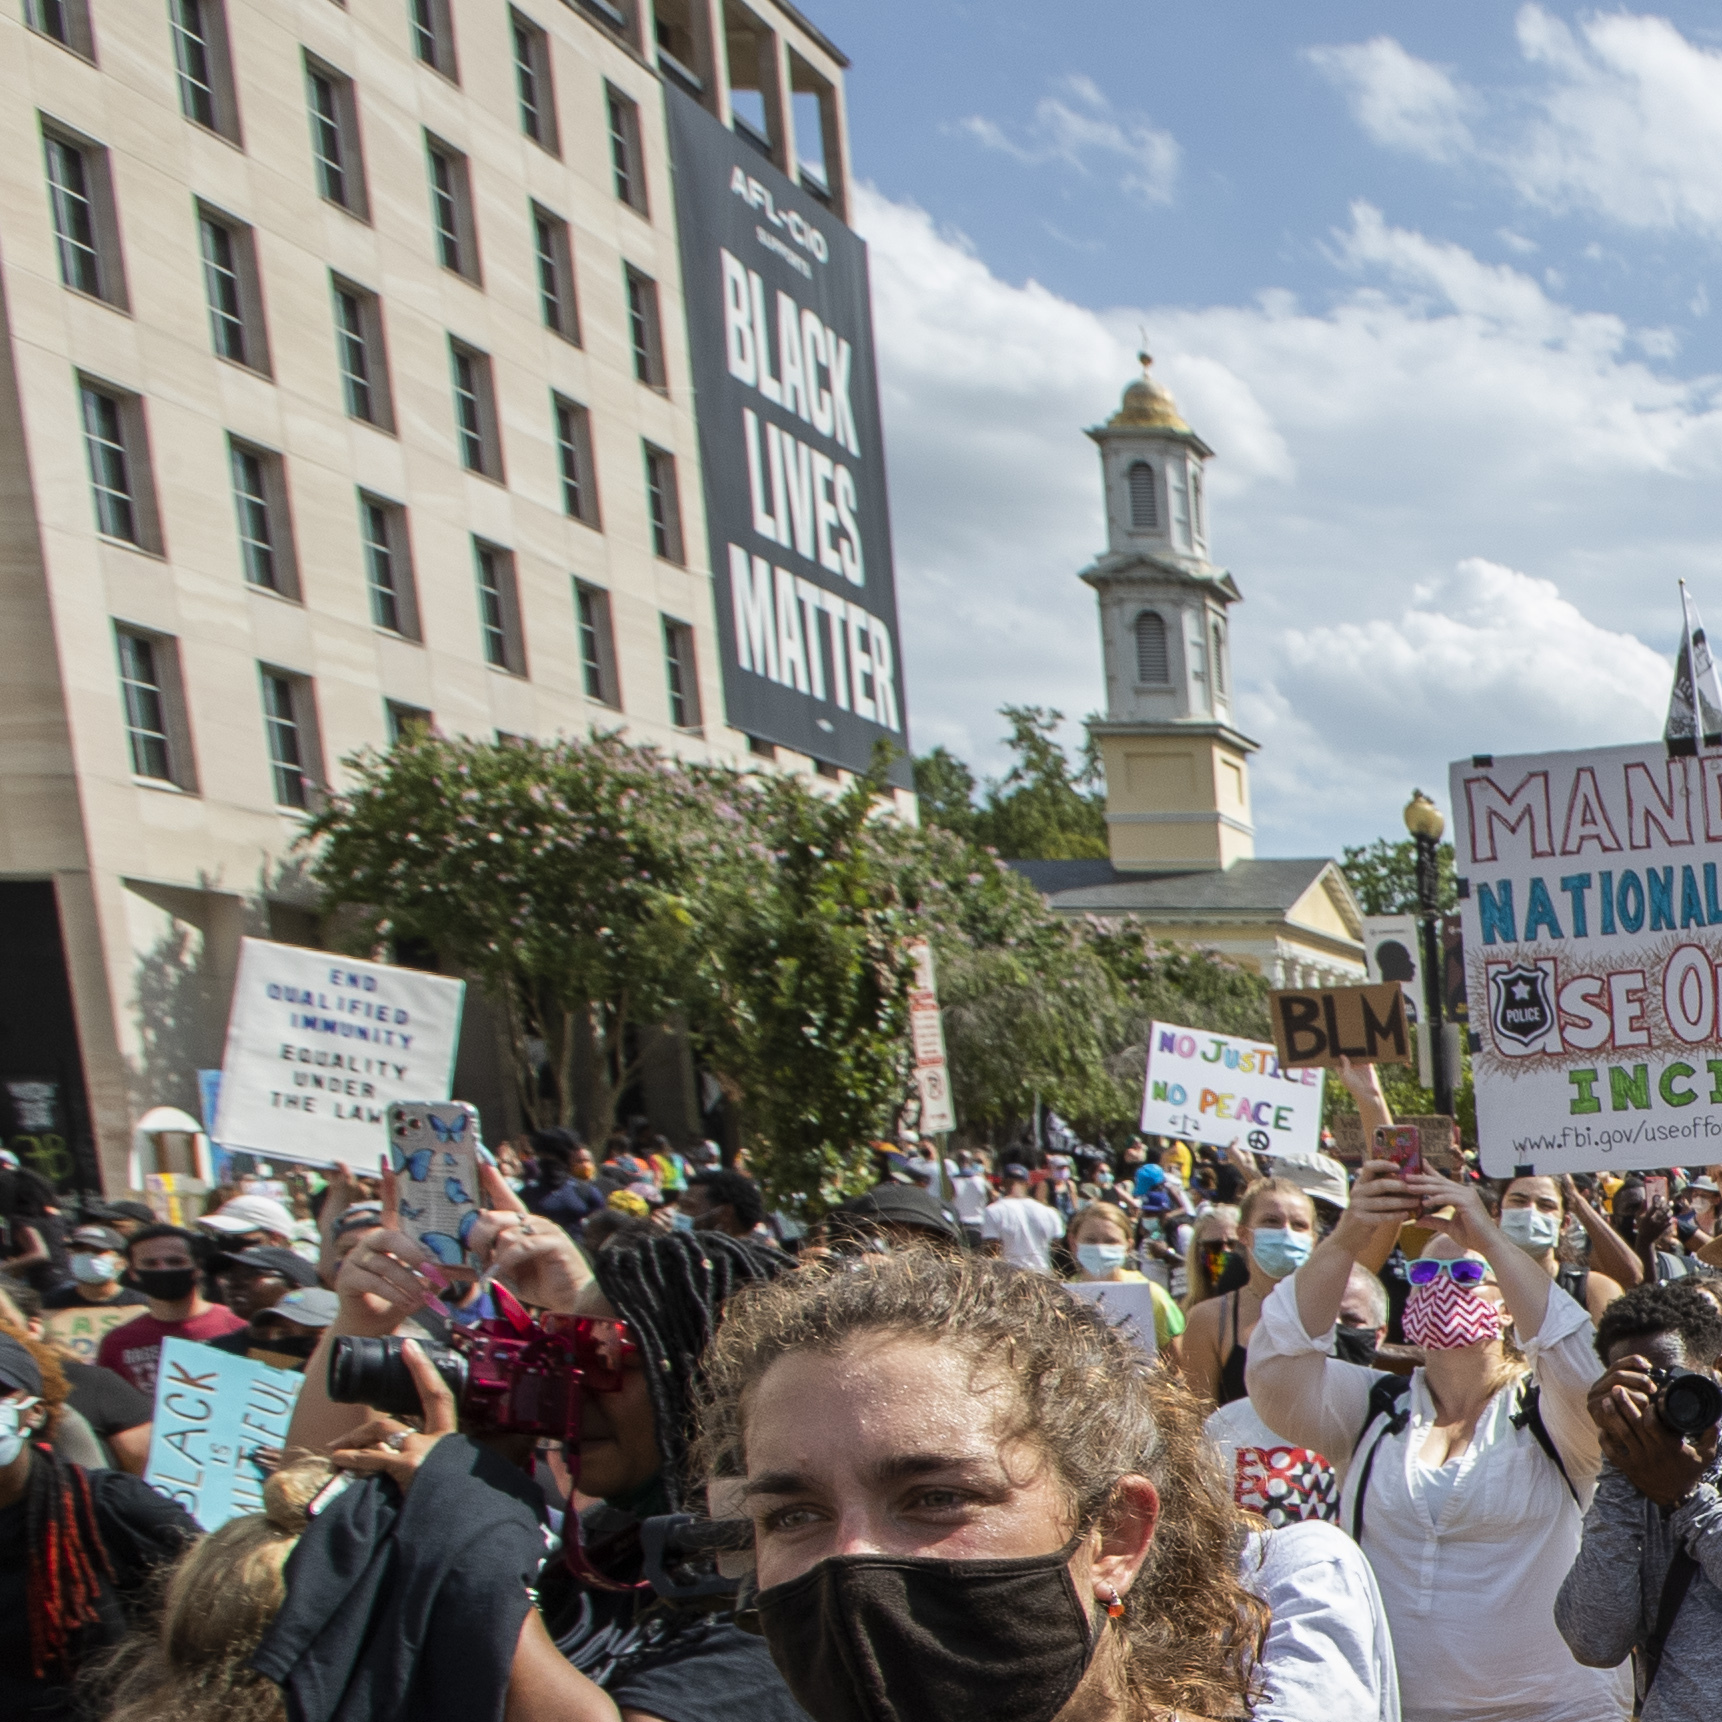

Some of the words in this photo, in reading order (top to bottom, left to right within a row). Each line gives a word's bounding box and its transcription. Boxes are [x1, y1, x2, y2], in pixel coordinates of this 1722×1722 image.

[730, 163, 829, 264] AFL-CIO
[720, 246, 861, 459] BLACK
[743, 406, 867, 588] LIVES
[727, 542, 901, 735] MATTER
[265, 982, 411, 1026] QUALIFIED
[328, 968, 378, 992] END
[290, 1012, 413, 1051] IMMUNITY
[1278, 990, 1408, 1062] BLM
[1485, 957, 1652, 1059] USE
[1505, 1006, 1541, 1024] POLICE
[280, 1043, 408, 1081] EQUALITY
[293, 1070, 376, 1098] UNDER
[1159, 1029, 1196, 1058] NO
[1200, 1038, 1319, 1087] JUSTICE
[271, 1090, 316, 1113] THE
[334, 1102, 383, 1125] LAW
[1152, 1079, 1188, 1106] NO
[1199, 1087, 1294, 1132] PEACE
[153, 1360, 220, 1516] BLACK
[209, 1443, 231, 1466] IS
